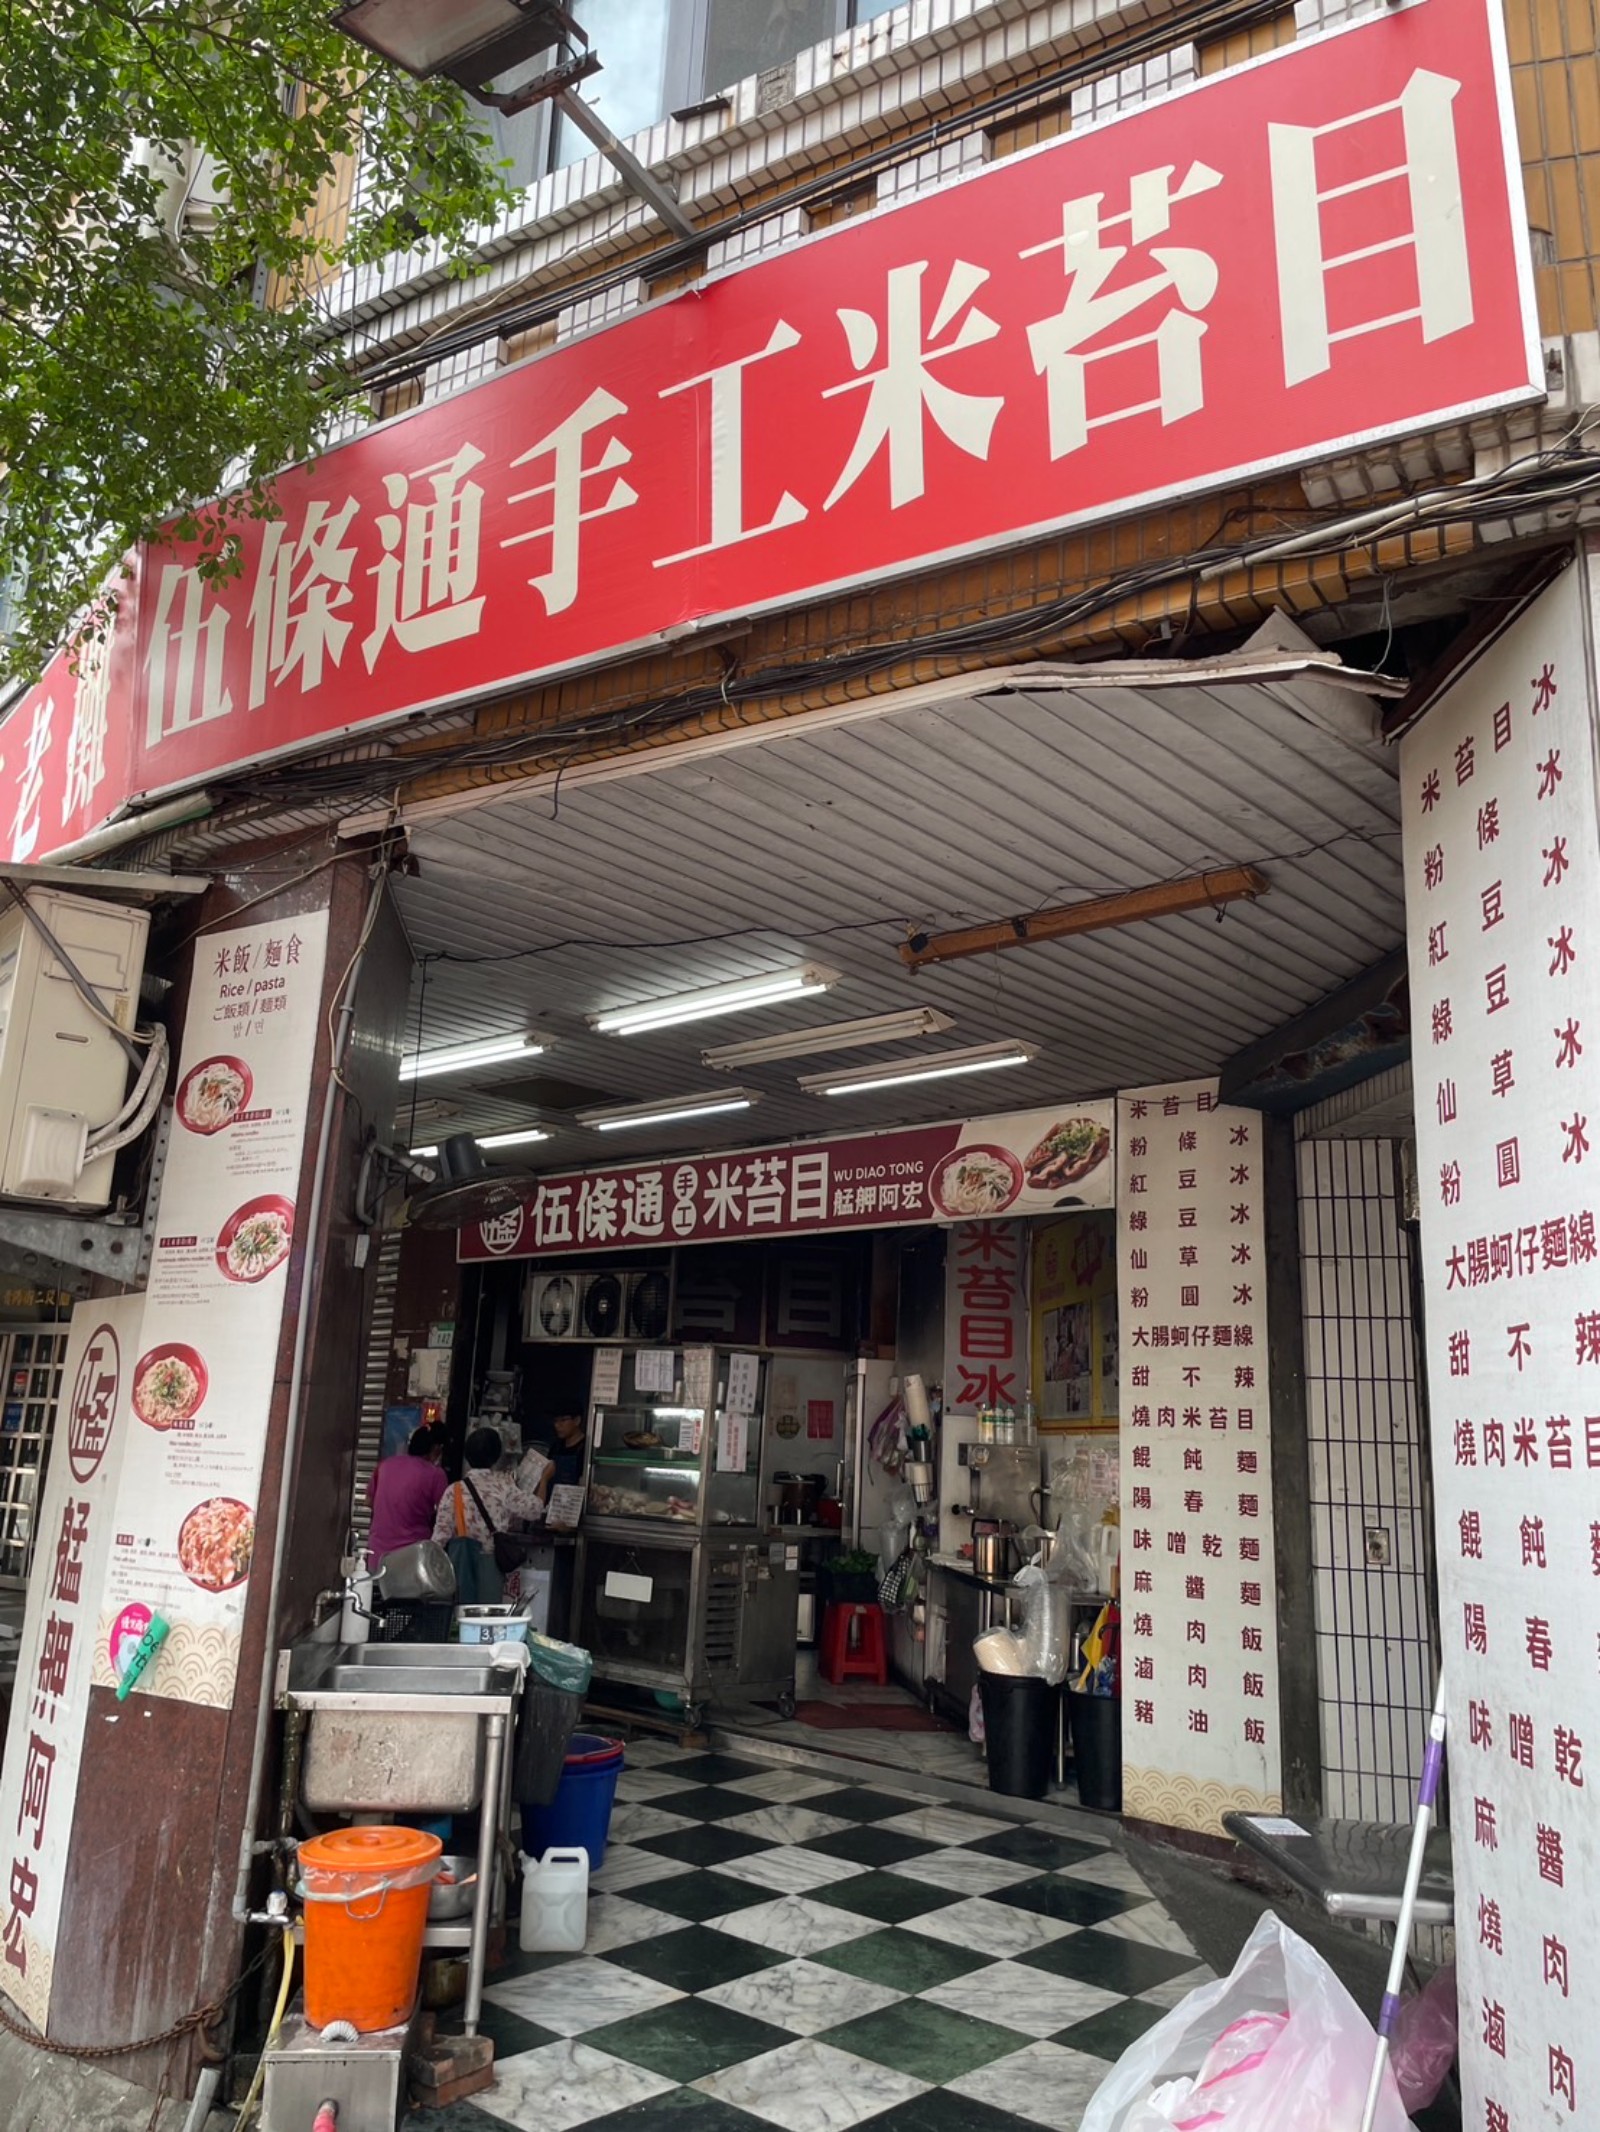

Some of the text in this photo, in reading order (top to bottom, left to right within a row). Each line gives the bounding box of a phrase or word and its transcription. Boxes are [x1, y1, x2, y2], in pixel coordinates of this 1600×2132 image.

[144, 67, 1474, 749] 伍條通手工米苔目
[220, 983, 244, 998] Rice
[254, 976, 285, 996] pasta
[834, 1160, 924, 1182] WU DIAO TONG
[531, 1170, 665, 1247] 伍條通
[703, 1152, 830, 1229] 米苔目
[833, 1181, 924, 1217] 艋舺阿宏
[1445, 1210, 1598, 1290] 大腸蚵仔麵線
[956, 1221, 1016, 1408] 米苔目冰
[1132, 1325, 1254, 1348] 大腸蚵仔麵線
[1132, 1366, 1255, 1388] 甜不辣
[1132, 1405, 1254, 1431] 燒肉米苔目
[1133, 1445, 1258, 1474] 餛飩麵
[1133, 1486, 1258, 1517] 陽春麵
[1133, 1528, 1260, 1562] 味噌乾麵
[1134, 1570, 1262, 1607] 麻醬麵
[1134, 1613, 1263, 1652] 燒肉飯
[1463, 1602, 1600, 1675] 陽春
[1135, 1656, 1264, 1698] 滷肉飯
[1135, 1699, 1265, 1745] 豬油飯
